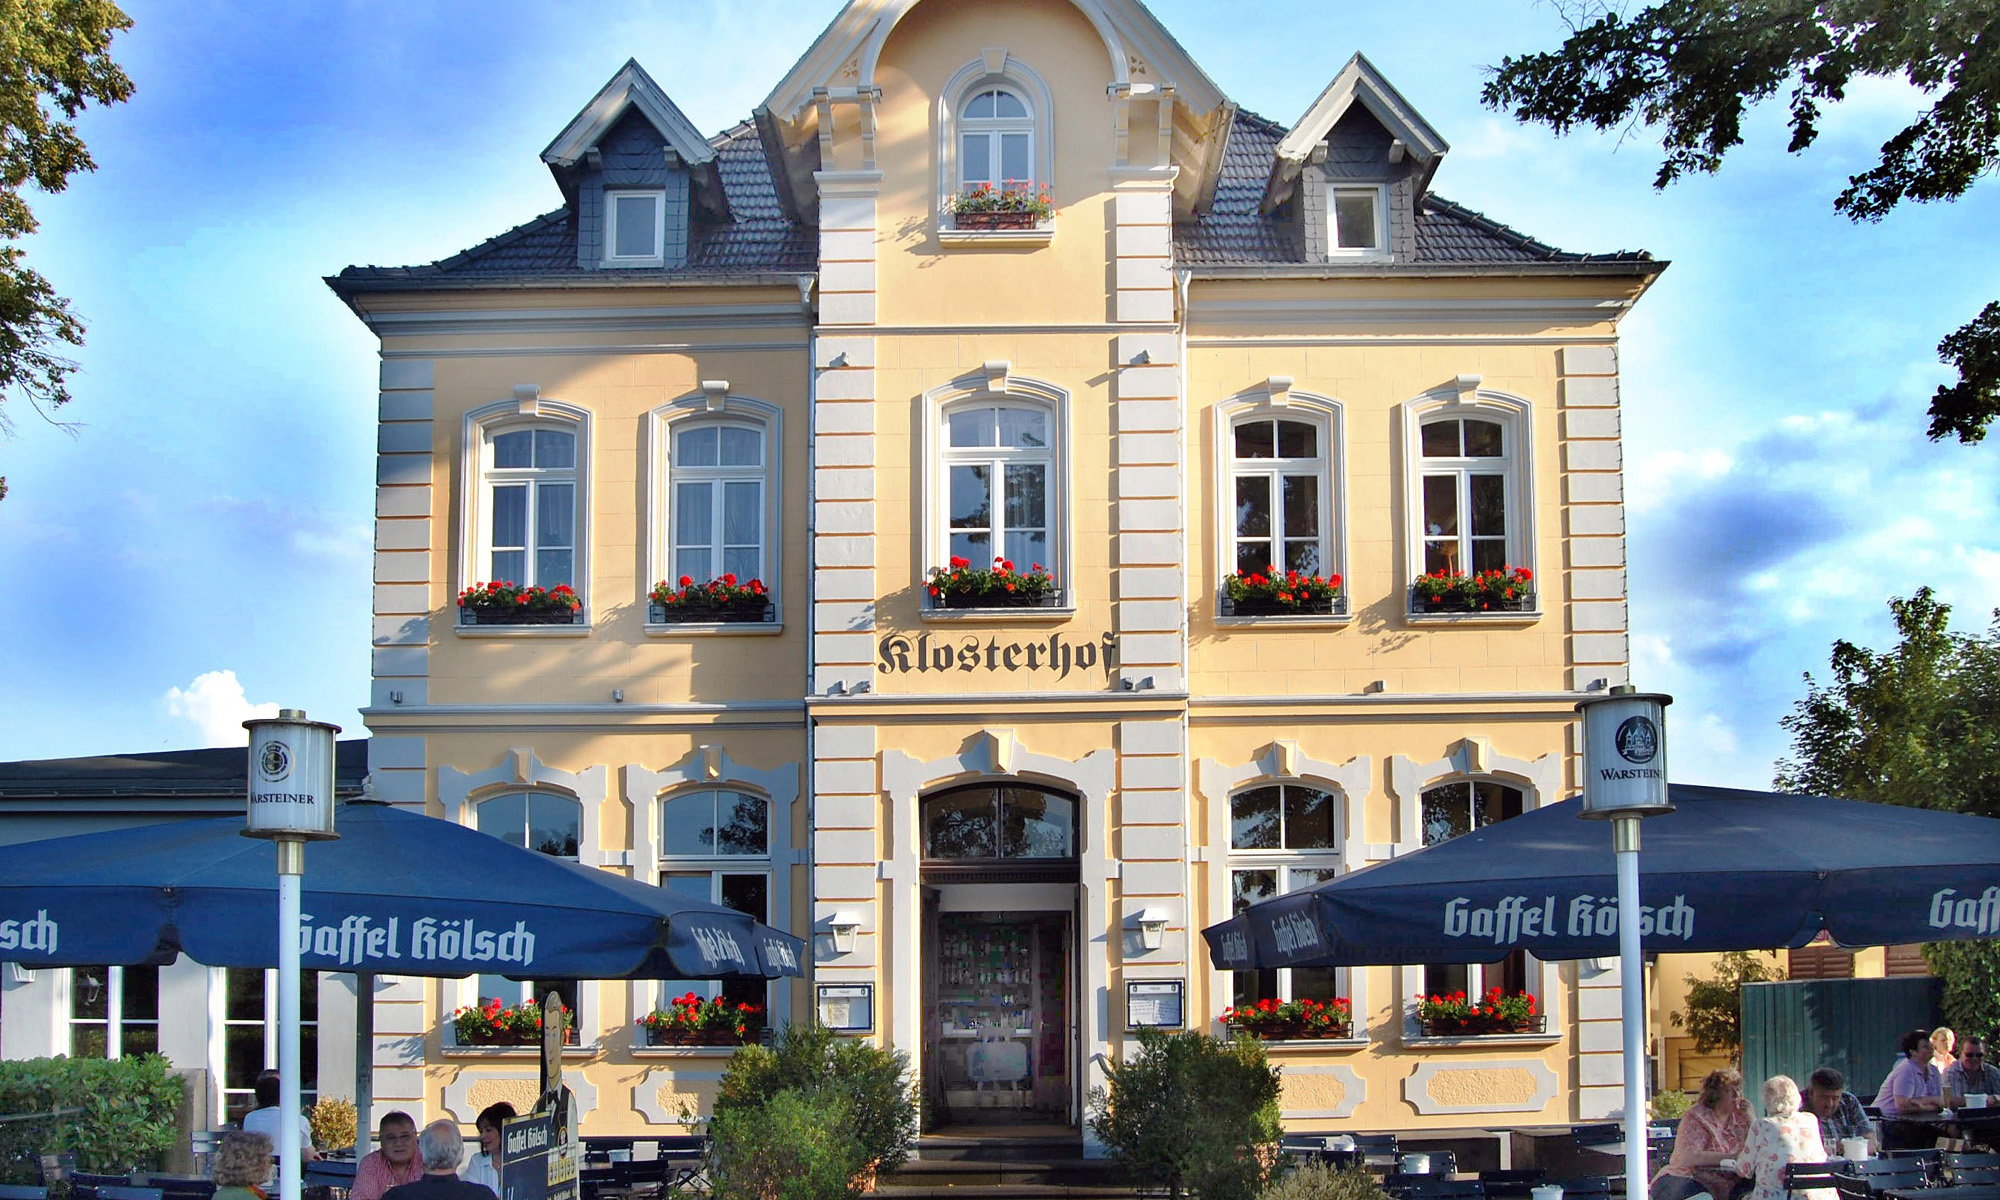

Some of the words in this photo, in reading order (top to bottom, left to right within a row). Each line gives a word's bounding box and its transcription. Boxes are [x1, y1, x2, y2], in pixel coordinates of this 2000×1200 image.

[878, 631, 1116, 683] Klosterhof
[250, 791, 315, 805] ARSTEINER
[1600, 767, 1663, 781] WARSTEIN
[411, 916, 536, 967] Kölsch
[1443, 895, 1558, 945] Gaffel
[1567, 894, 1695, 941] Kösch
